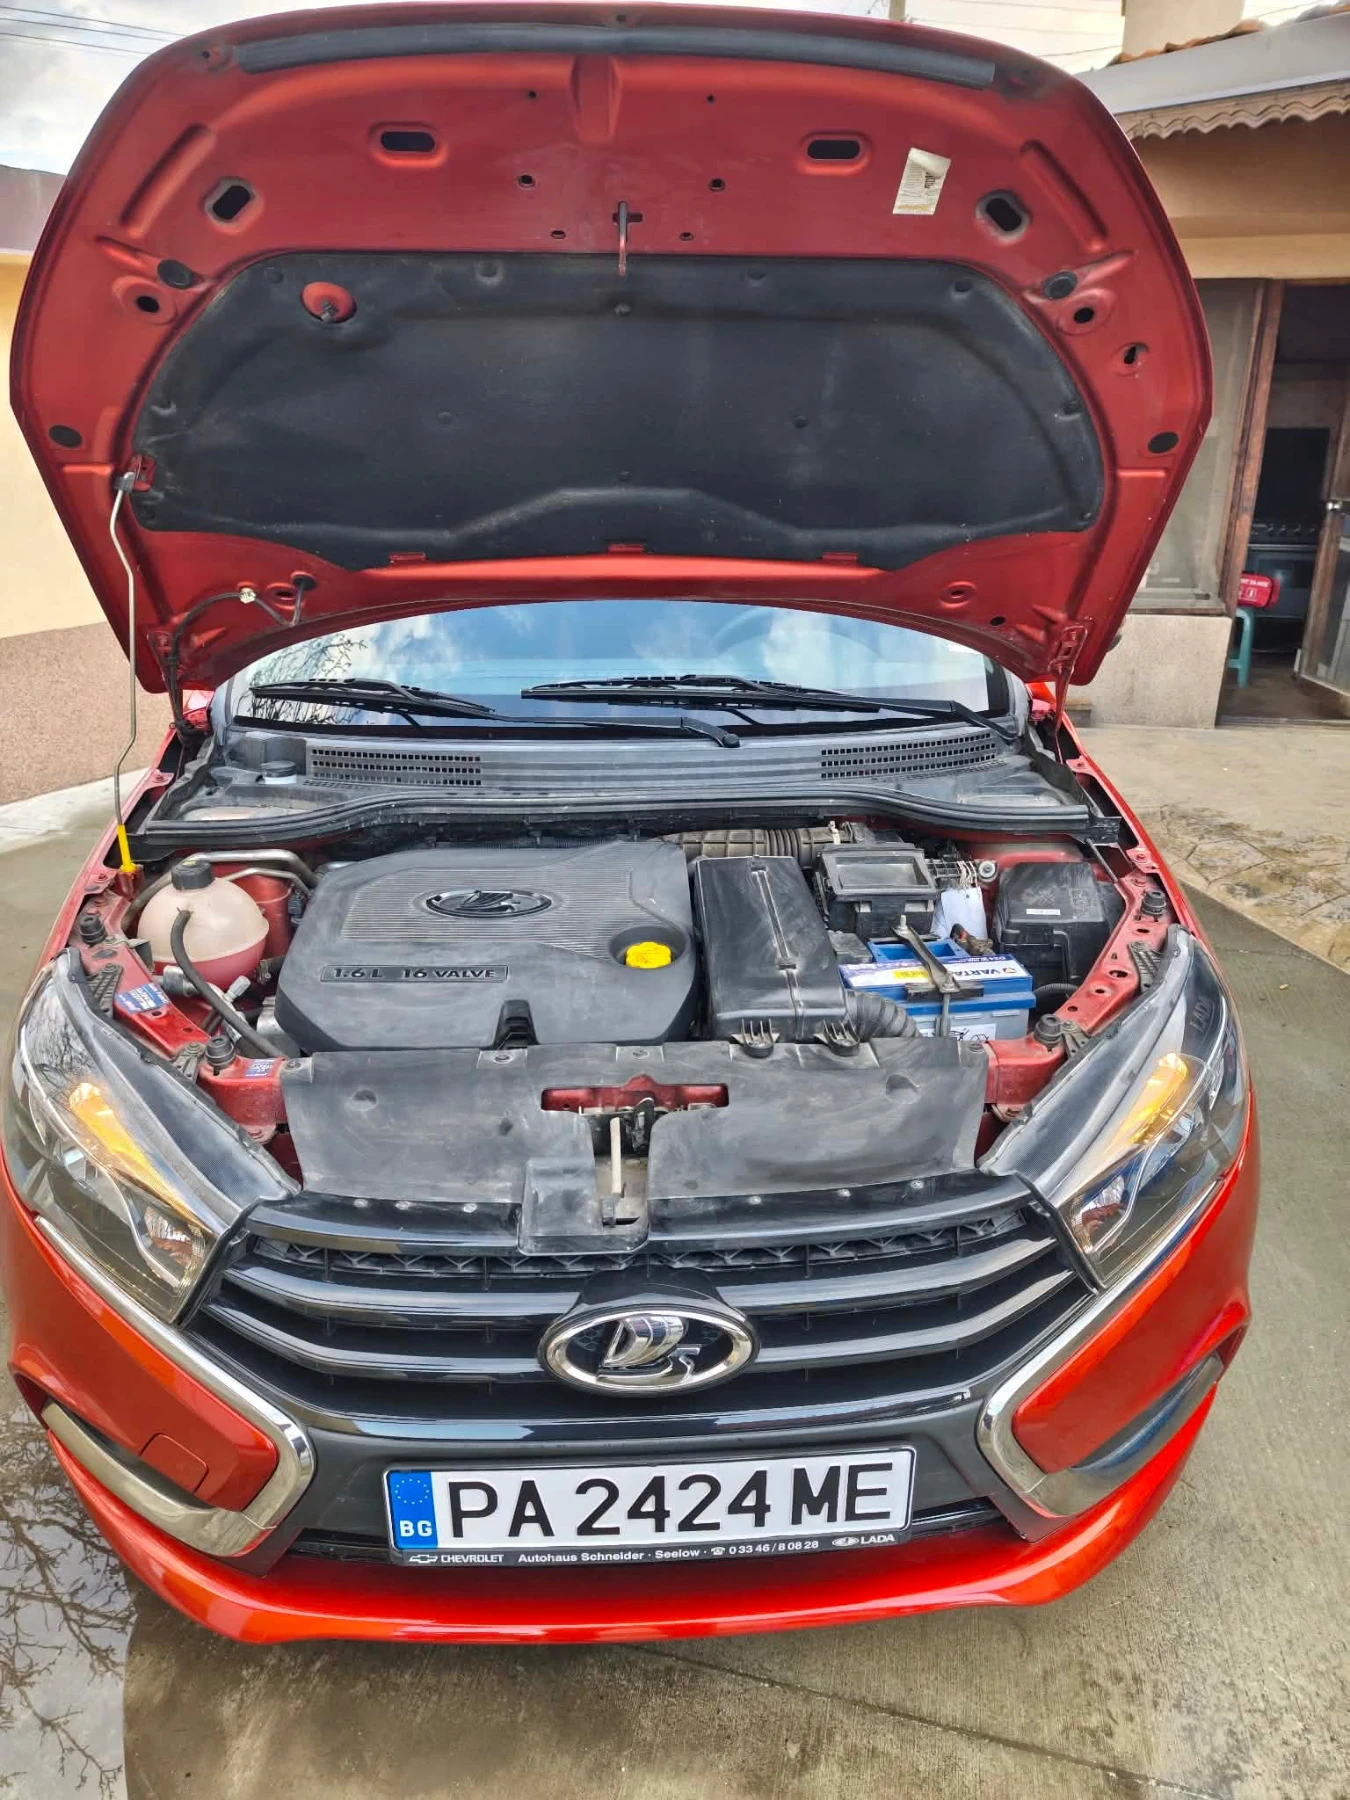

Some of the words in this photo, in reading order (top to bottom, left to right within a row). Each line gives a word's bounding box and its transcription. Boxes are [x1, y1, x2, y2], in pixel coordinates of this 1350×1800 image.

[401, 967, 428, 978] 16
[433, 969, 496, 978] VALVE
[954, 968, 1000, 977] VARTA
[448, 1479, 555, 1538] PA
[574, 1470, 771, 1537] 2424
[791, 1462, 893, 1526] ME
[399, 1519, 432, 1538] BG
[860, 1533, 895, 1544] LADA
[440, 1554, 504, 1563] CHEVROLET
[518, 1553, 577, 1563] Autohaus
[581, 1551, 644, 1562] Schneider
[655, 1549, 700, 1559] Seelow
